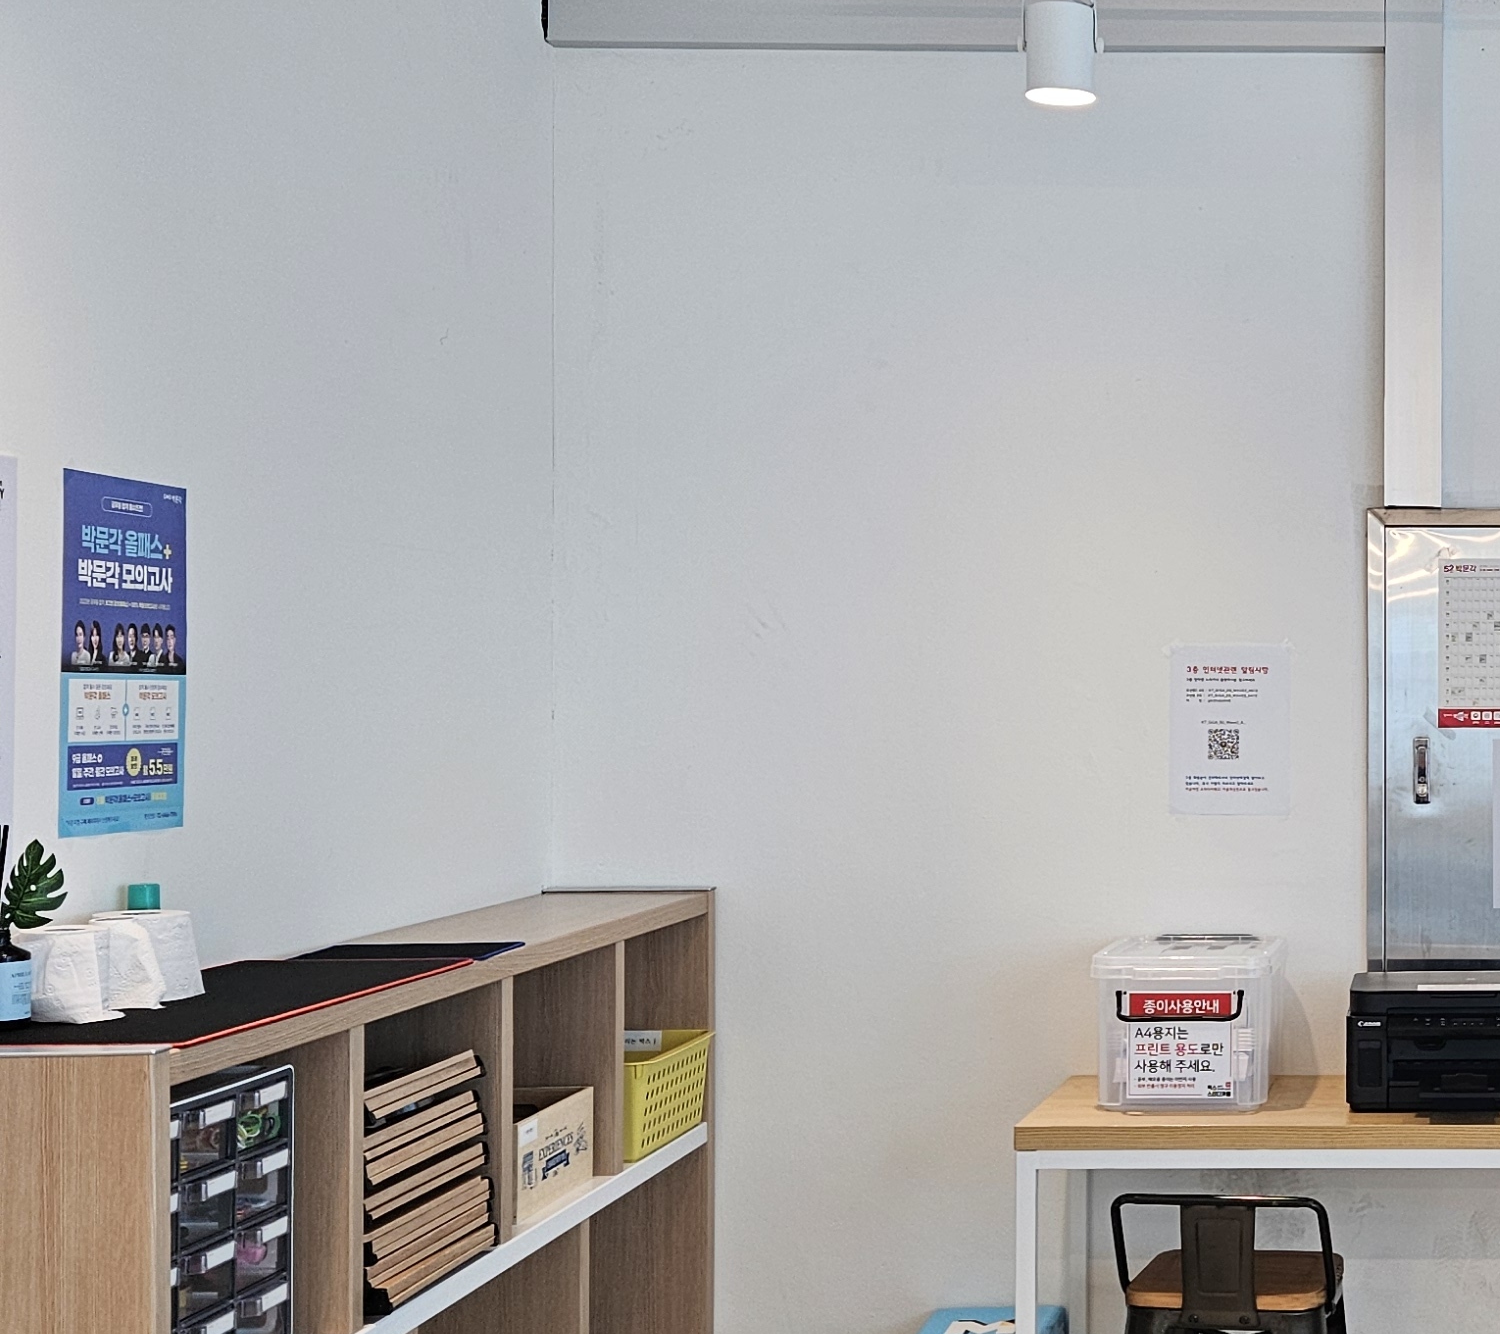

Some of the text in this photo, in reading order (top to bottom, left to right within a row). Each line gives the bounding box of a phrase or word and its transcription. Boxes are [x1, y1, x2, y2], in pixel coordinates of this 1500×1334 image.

[82, 524, 123, 556] 박문각
[78, 558, 173, 594] 박문각 모의고사
[1143, 999, 1220, 1014] 종이사용안내
[1135, 1026, 1189, 1040] A4용지는
[1134, 1043, 1224, 1056] 프린트 용도로만
[1134, 1059, 1215, 1073] 사용해 주세요.
